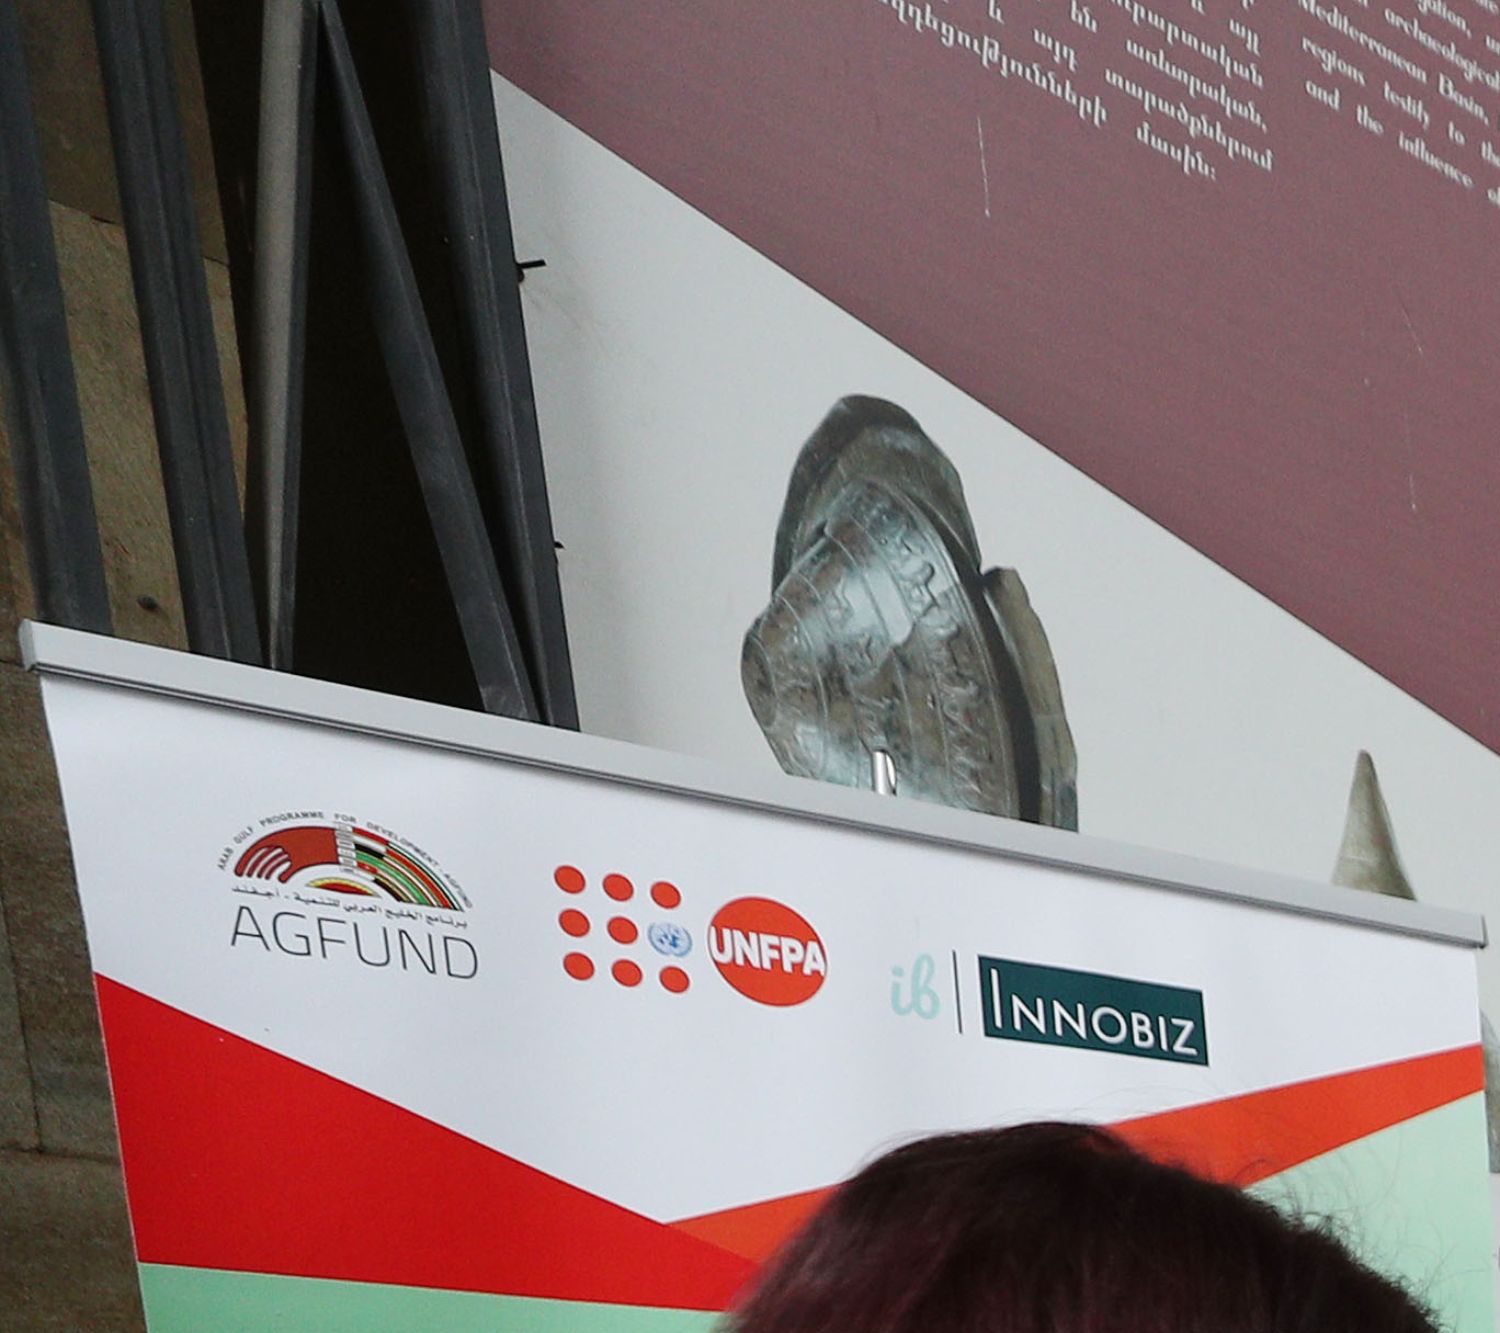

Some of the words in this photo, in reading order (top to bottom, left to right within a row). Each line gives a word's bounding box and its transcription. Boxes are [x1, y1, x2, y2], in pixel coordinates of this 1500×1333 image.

[1384, 8, 1500, 92] archaeological
[1302, 37, 1365, 86] regions
[1384, 80, 1430, 131] testify
[1449, 121, 1465, 145] to
[1439, 73, 1489, 126] Basin,
[1306, 80, 1340, 111] and
[1357, 105, 1383, 134] the
[1399, 130, 1473, 188] influence
[234, 827, 254, 844] GULF
[259, 811, 324, 828] PROGRAMME
[334, 813, 357, 824] FOR
[366, 821, 438, 869] DEVELOPMENT
[231, 905, 478, 980] AGFUND
[709, 924, 827, 977] UNFPA
